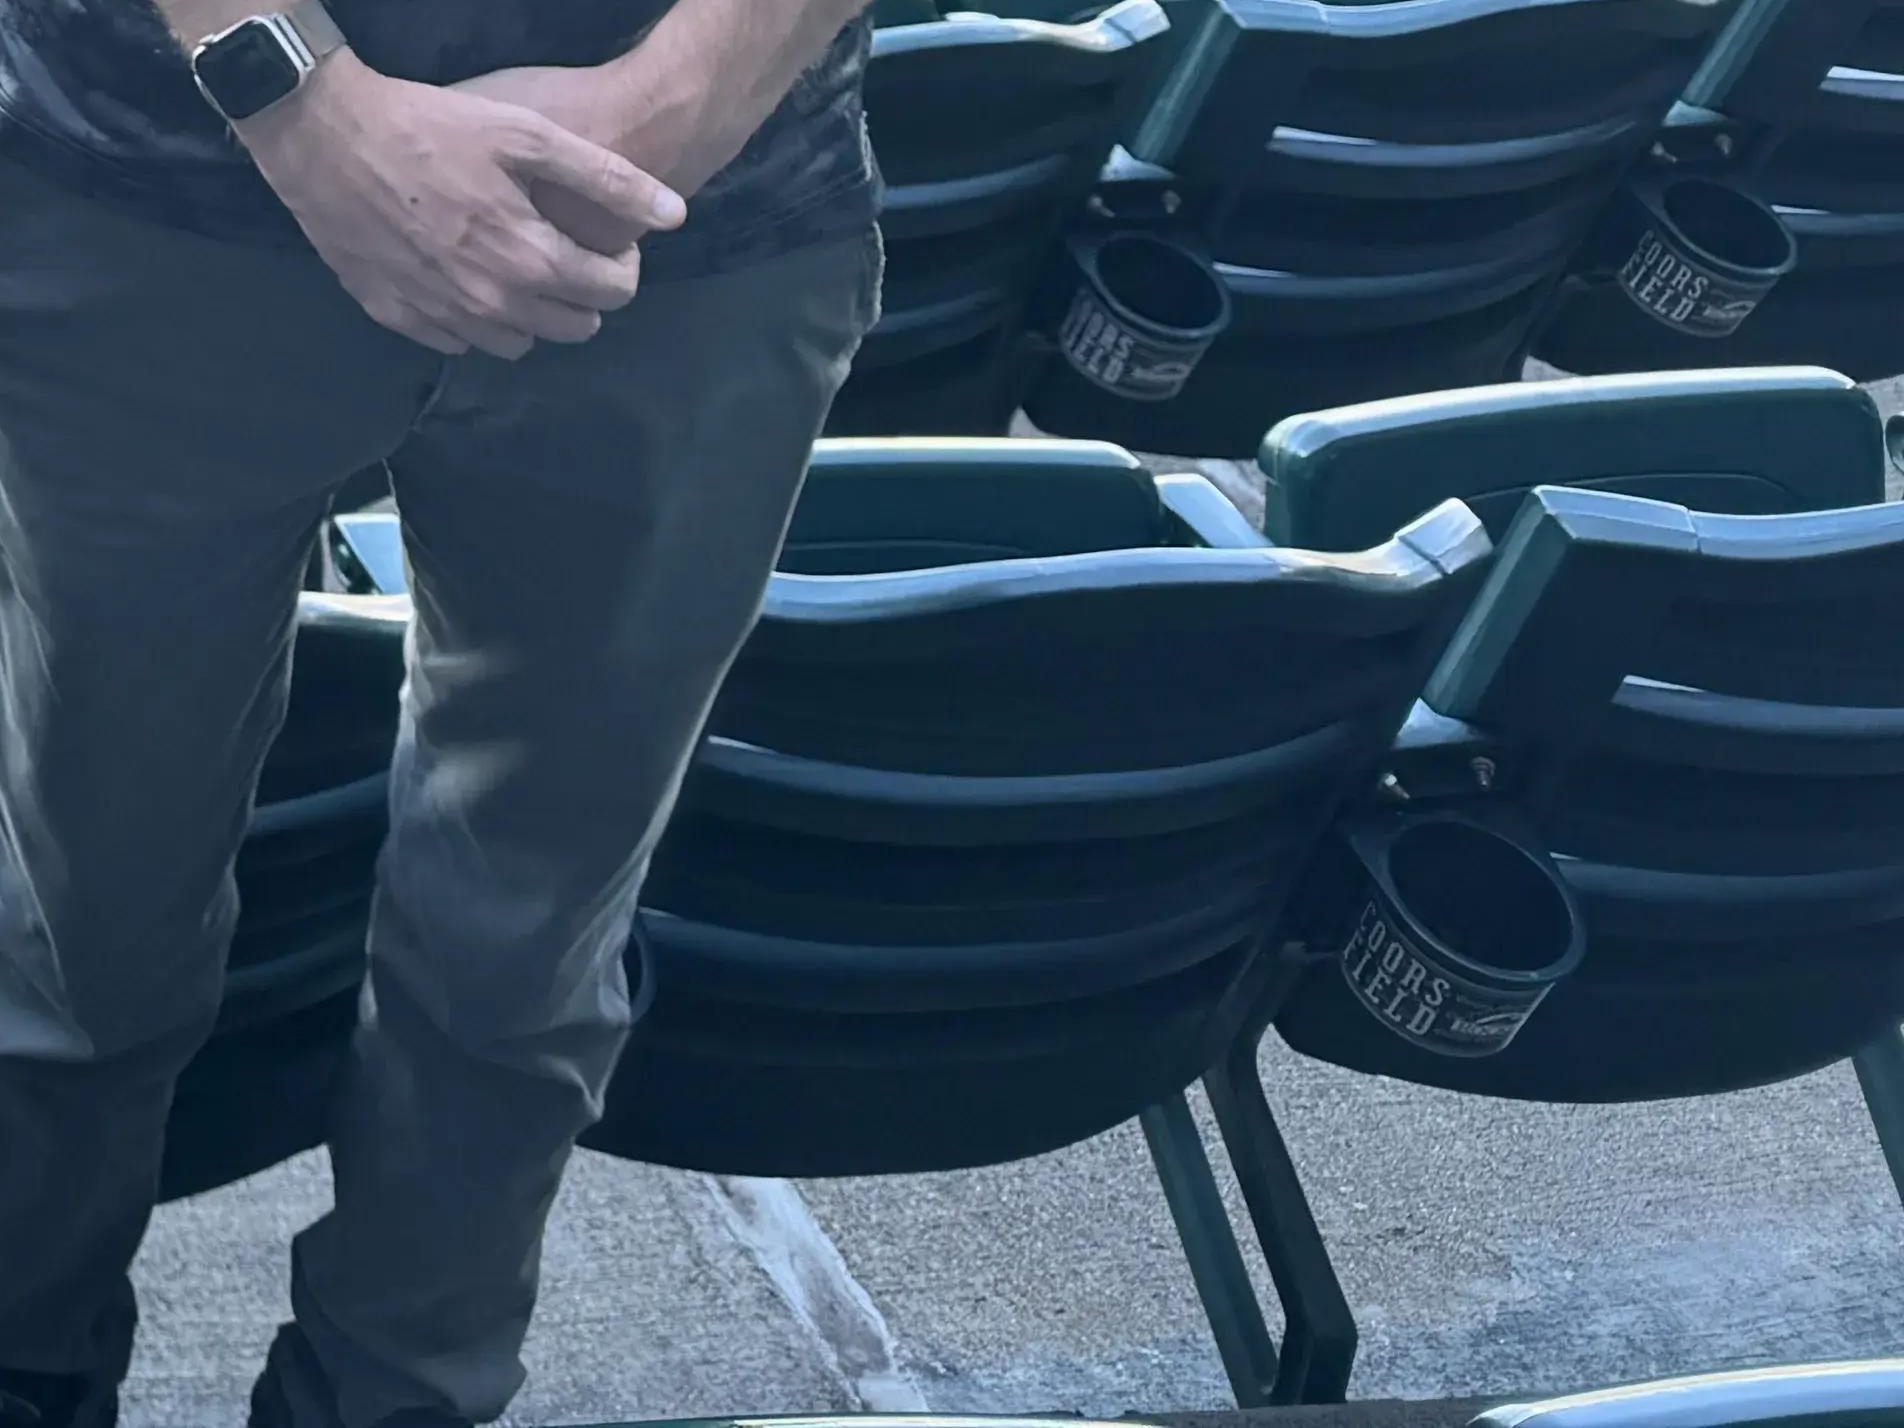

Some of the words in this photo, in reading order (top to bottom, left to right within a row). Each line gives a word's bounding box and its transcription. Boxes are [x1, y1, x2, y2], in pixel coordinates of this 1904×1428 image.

[1621, 253, 1696, 323] FIELD
[1638, 229, 1709, 300] COORS
[1342, 929, 1438, 1036] FIELD
[1359, 899, 1451, 1006] COORS
